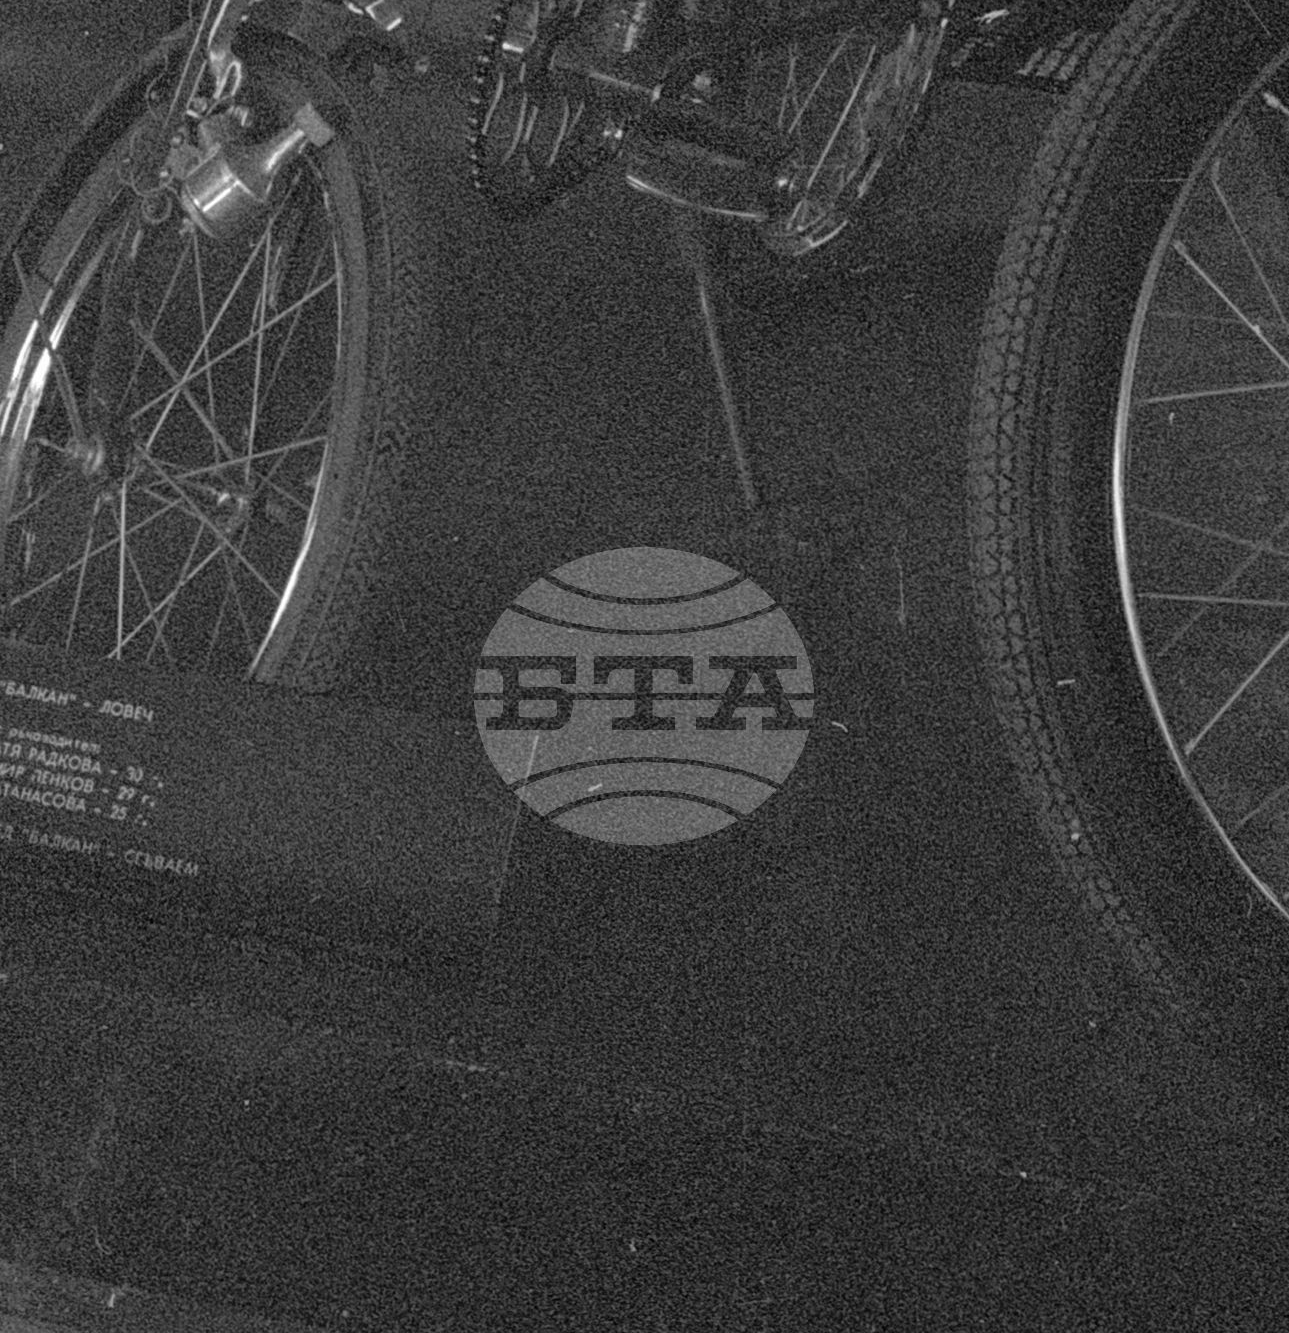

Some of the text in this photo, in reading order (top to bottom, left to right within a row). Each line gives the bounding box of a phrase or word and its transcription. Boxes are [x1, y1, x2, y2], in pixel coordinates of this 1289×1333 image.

[99, 699, 154, 722] ЛОВЕЧ
[29, 746, 101, 774] РАДКОВА
[126, 765, 144, 783] 30
[117, 785, 135, 800] 29
[110, 804, 127, 821] 25
